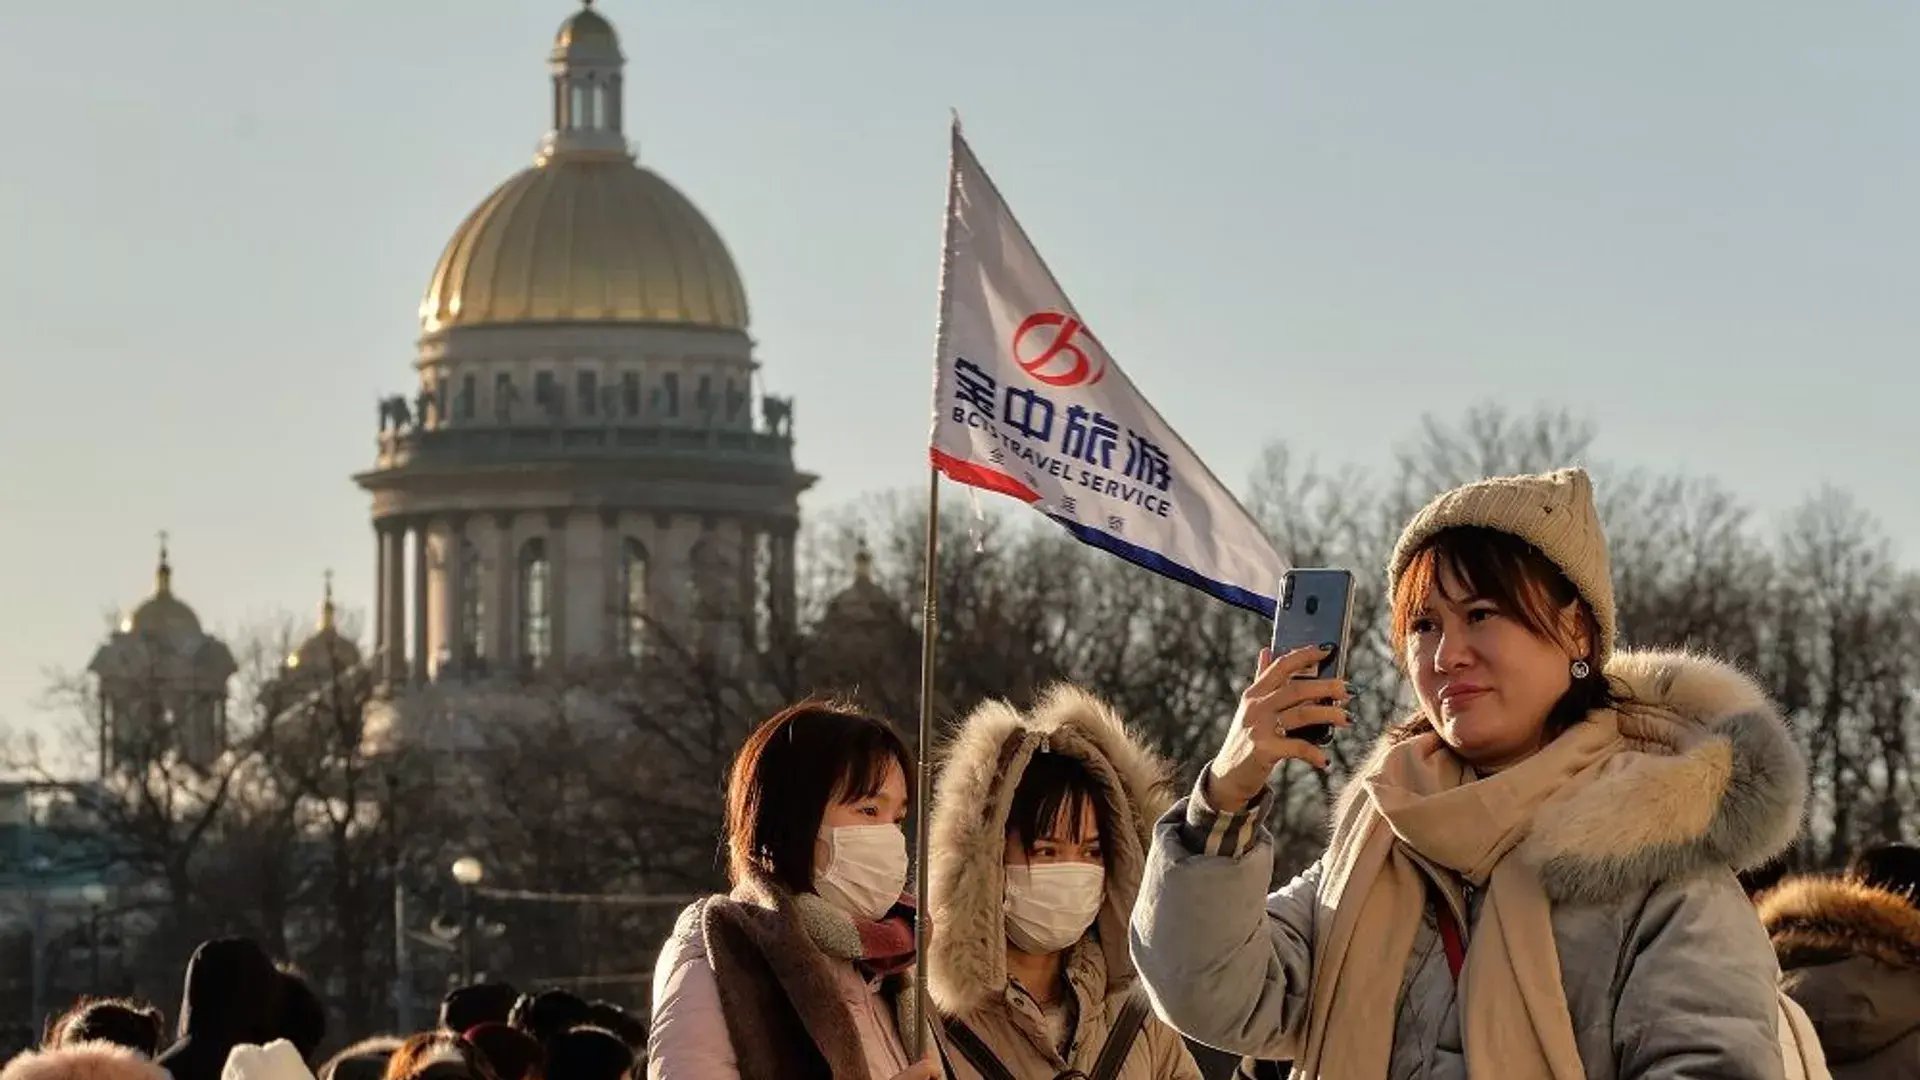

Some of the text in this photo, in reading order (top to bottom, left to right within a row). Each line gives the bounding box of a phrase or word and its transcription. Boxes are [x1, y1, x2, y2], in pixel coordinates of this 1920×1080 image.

[954, 357, 1171, 491] 宝中旅游
[1000, 432, 1073, 481] TRAVEL
[1079, 470, 1171, 517] SERVICE
